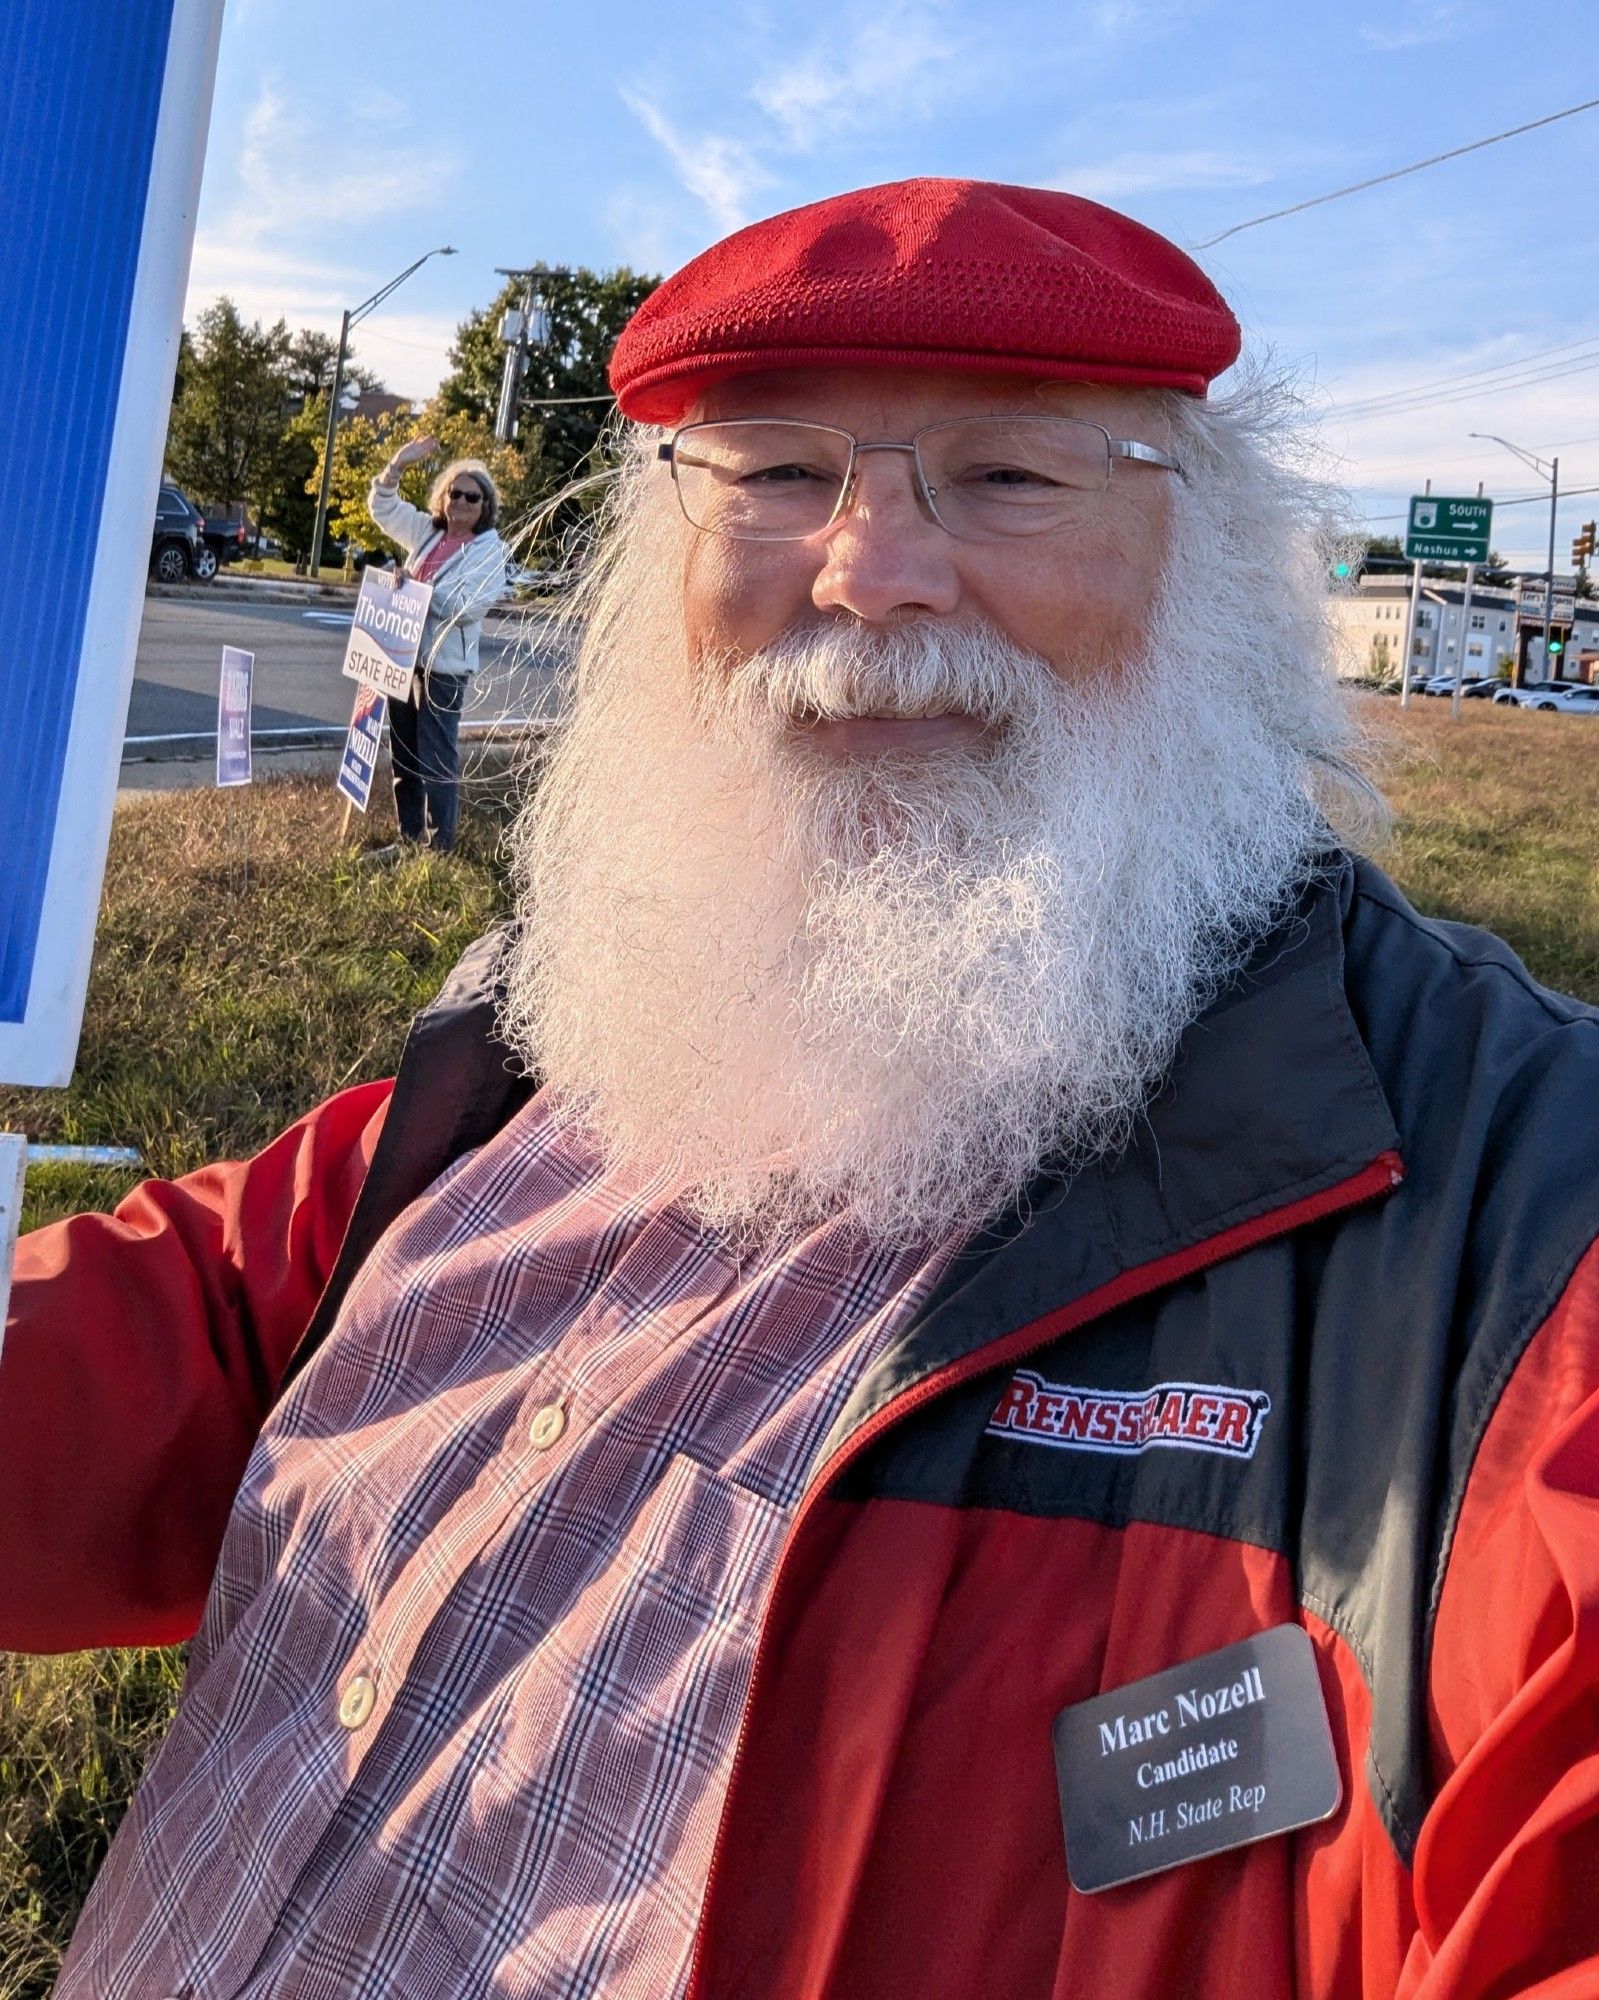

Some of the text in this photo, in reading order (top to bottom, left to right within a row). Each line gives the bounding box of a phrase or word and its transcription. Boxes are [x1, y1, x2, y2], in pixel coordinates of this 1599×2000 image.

[1449, 503, 1487, 517] SOUTH
[1413, 543, 1458, 556] Nashua
[357, 596, 422, 643] Thomas
[391, 593, 423, 616] WENDY
[348, 651, 408, 690] STATE REP
[1098, 1666, 1266, 1757] Marc Nozell
[1136, 1736, 1239, 1790] Candidate
[1128, 1783, 1267, 1846] N.H. State Rep
